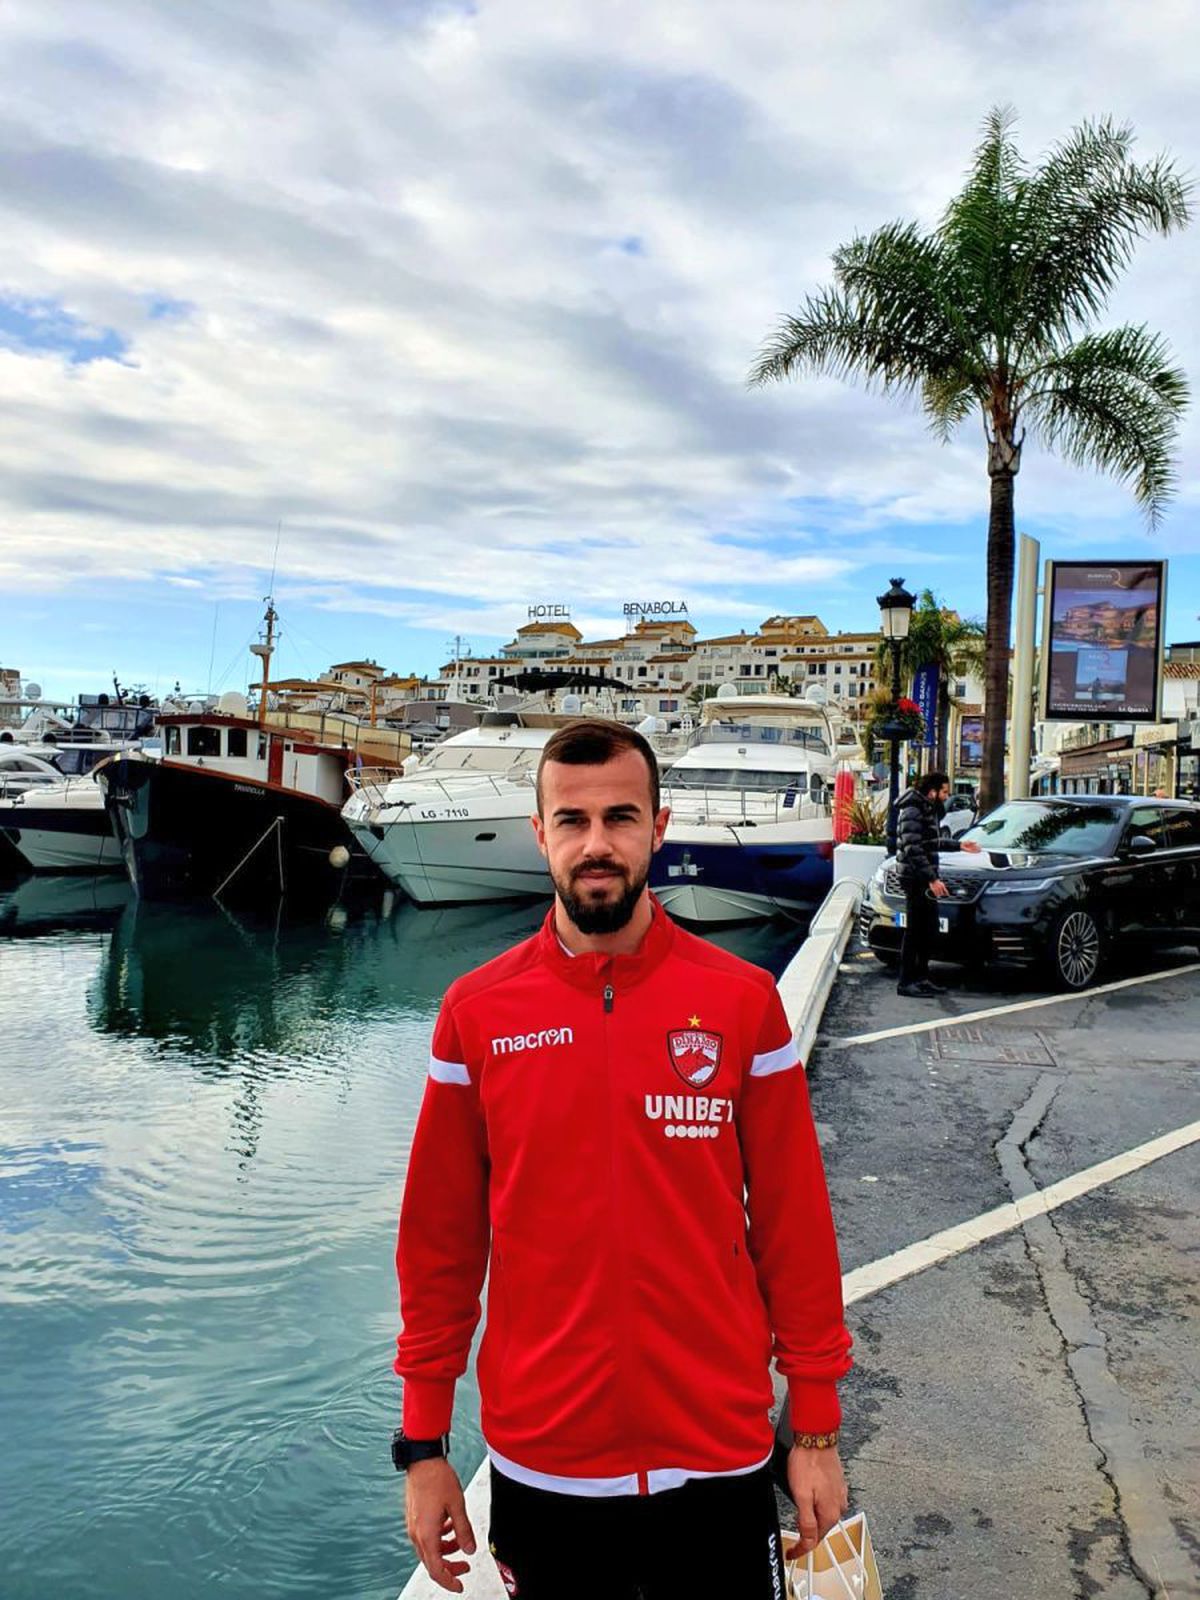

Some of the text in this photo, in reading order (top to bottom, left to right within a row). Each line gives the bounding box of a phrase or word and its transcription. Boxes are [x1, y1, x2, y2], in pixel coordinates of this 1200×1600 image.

[528, 601, 688, 617] HOTEL BENABOLA
[491, 1027, 573, 1056] macron
